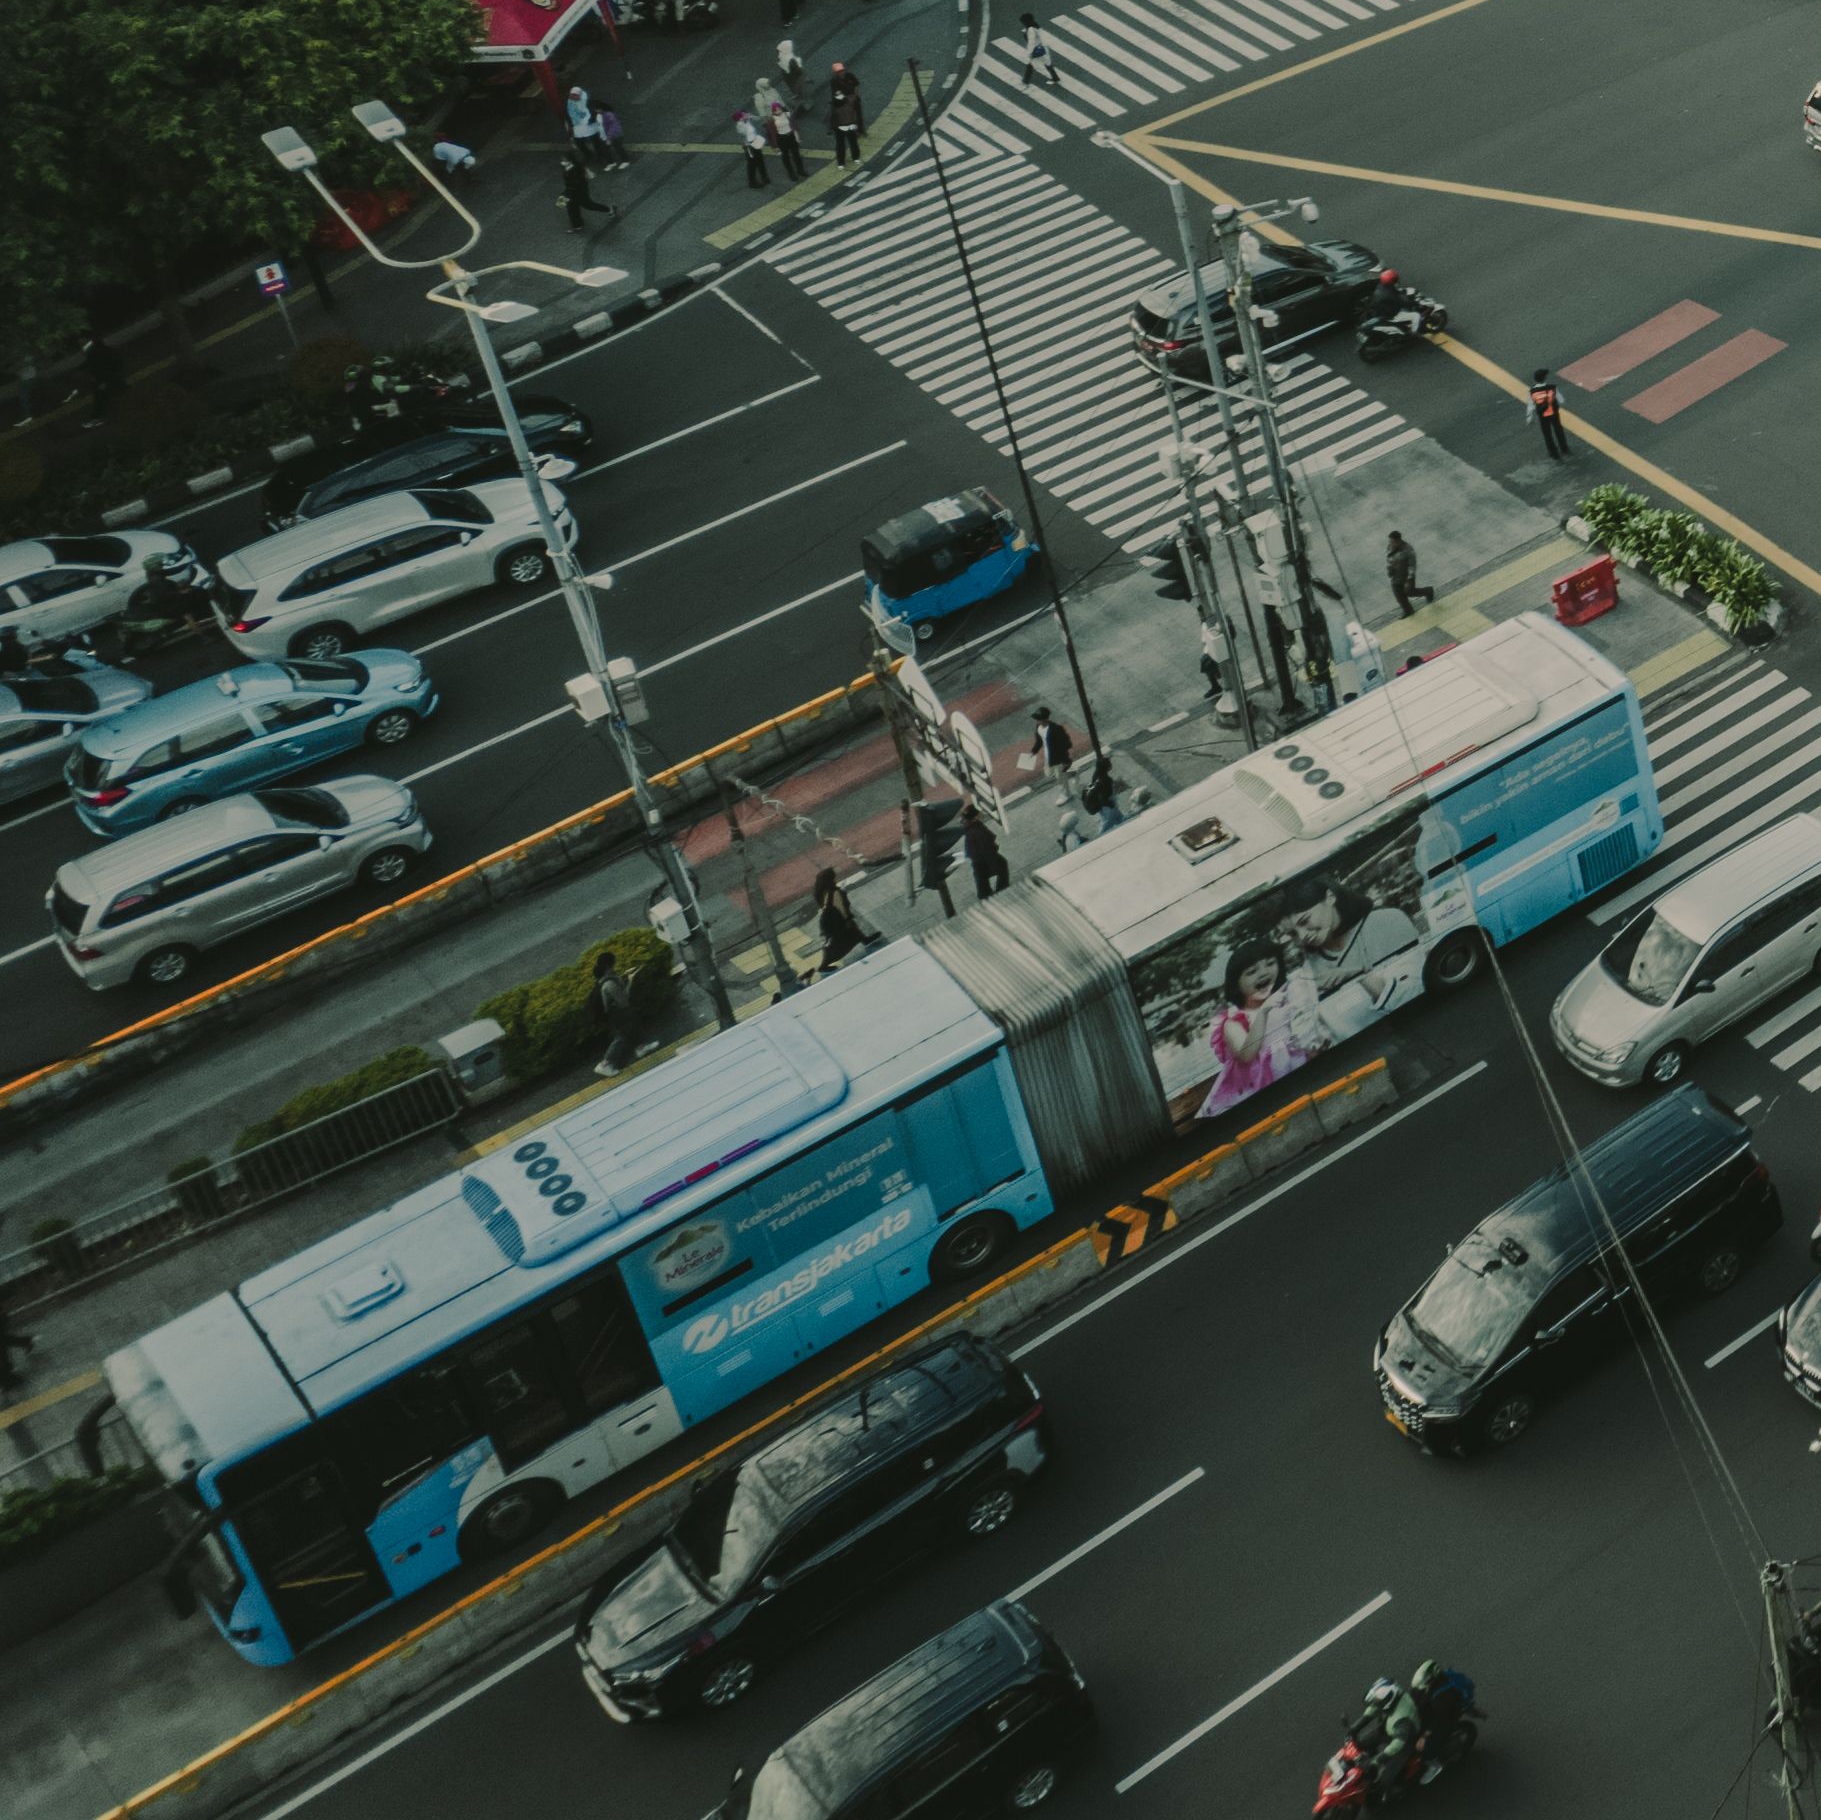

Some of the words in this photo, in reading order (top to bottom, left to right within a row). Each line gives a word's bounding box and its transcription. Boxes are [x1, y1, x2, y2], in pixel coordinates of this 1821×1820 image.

[736, 1179, 824, 1233] Kebaikan
[825, 1137, 894, 1183] Mineral
[767, 1166, 874, 1233] Terlindungi
[664, 1243, 726, 1283] Minerale
[682, 1248, 701, 1263] Le
[729, 1207, 911, 1329] transjakarta
